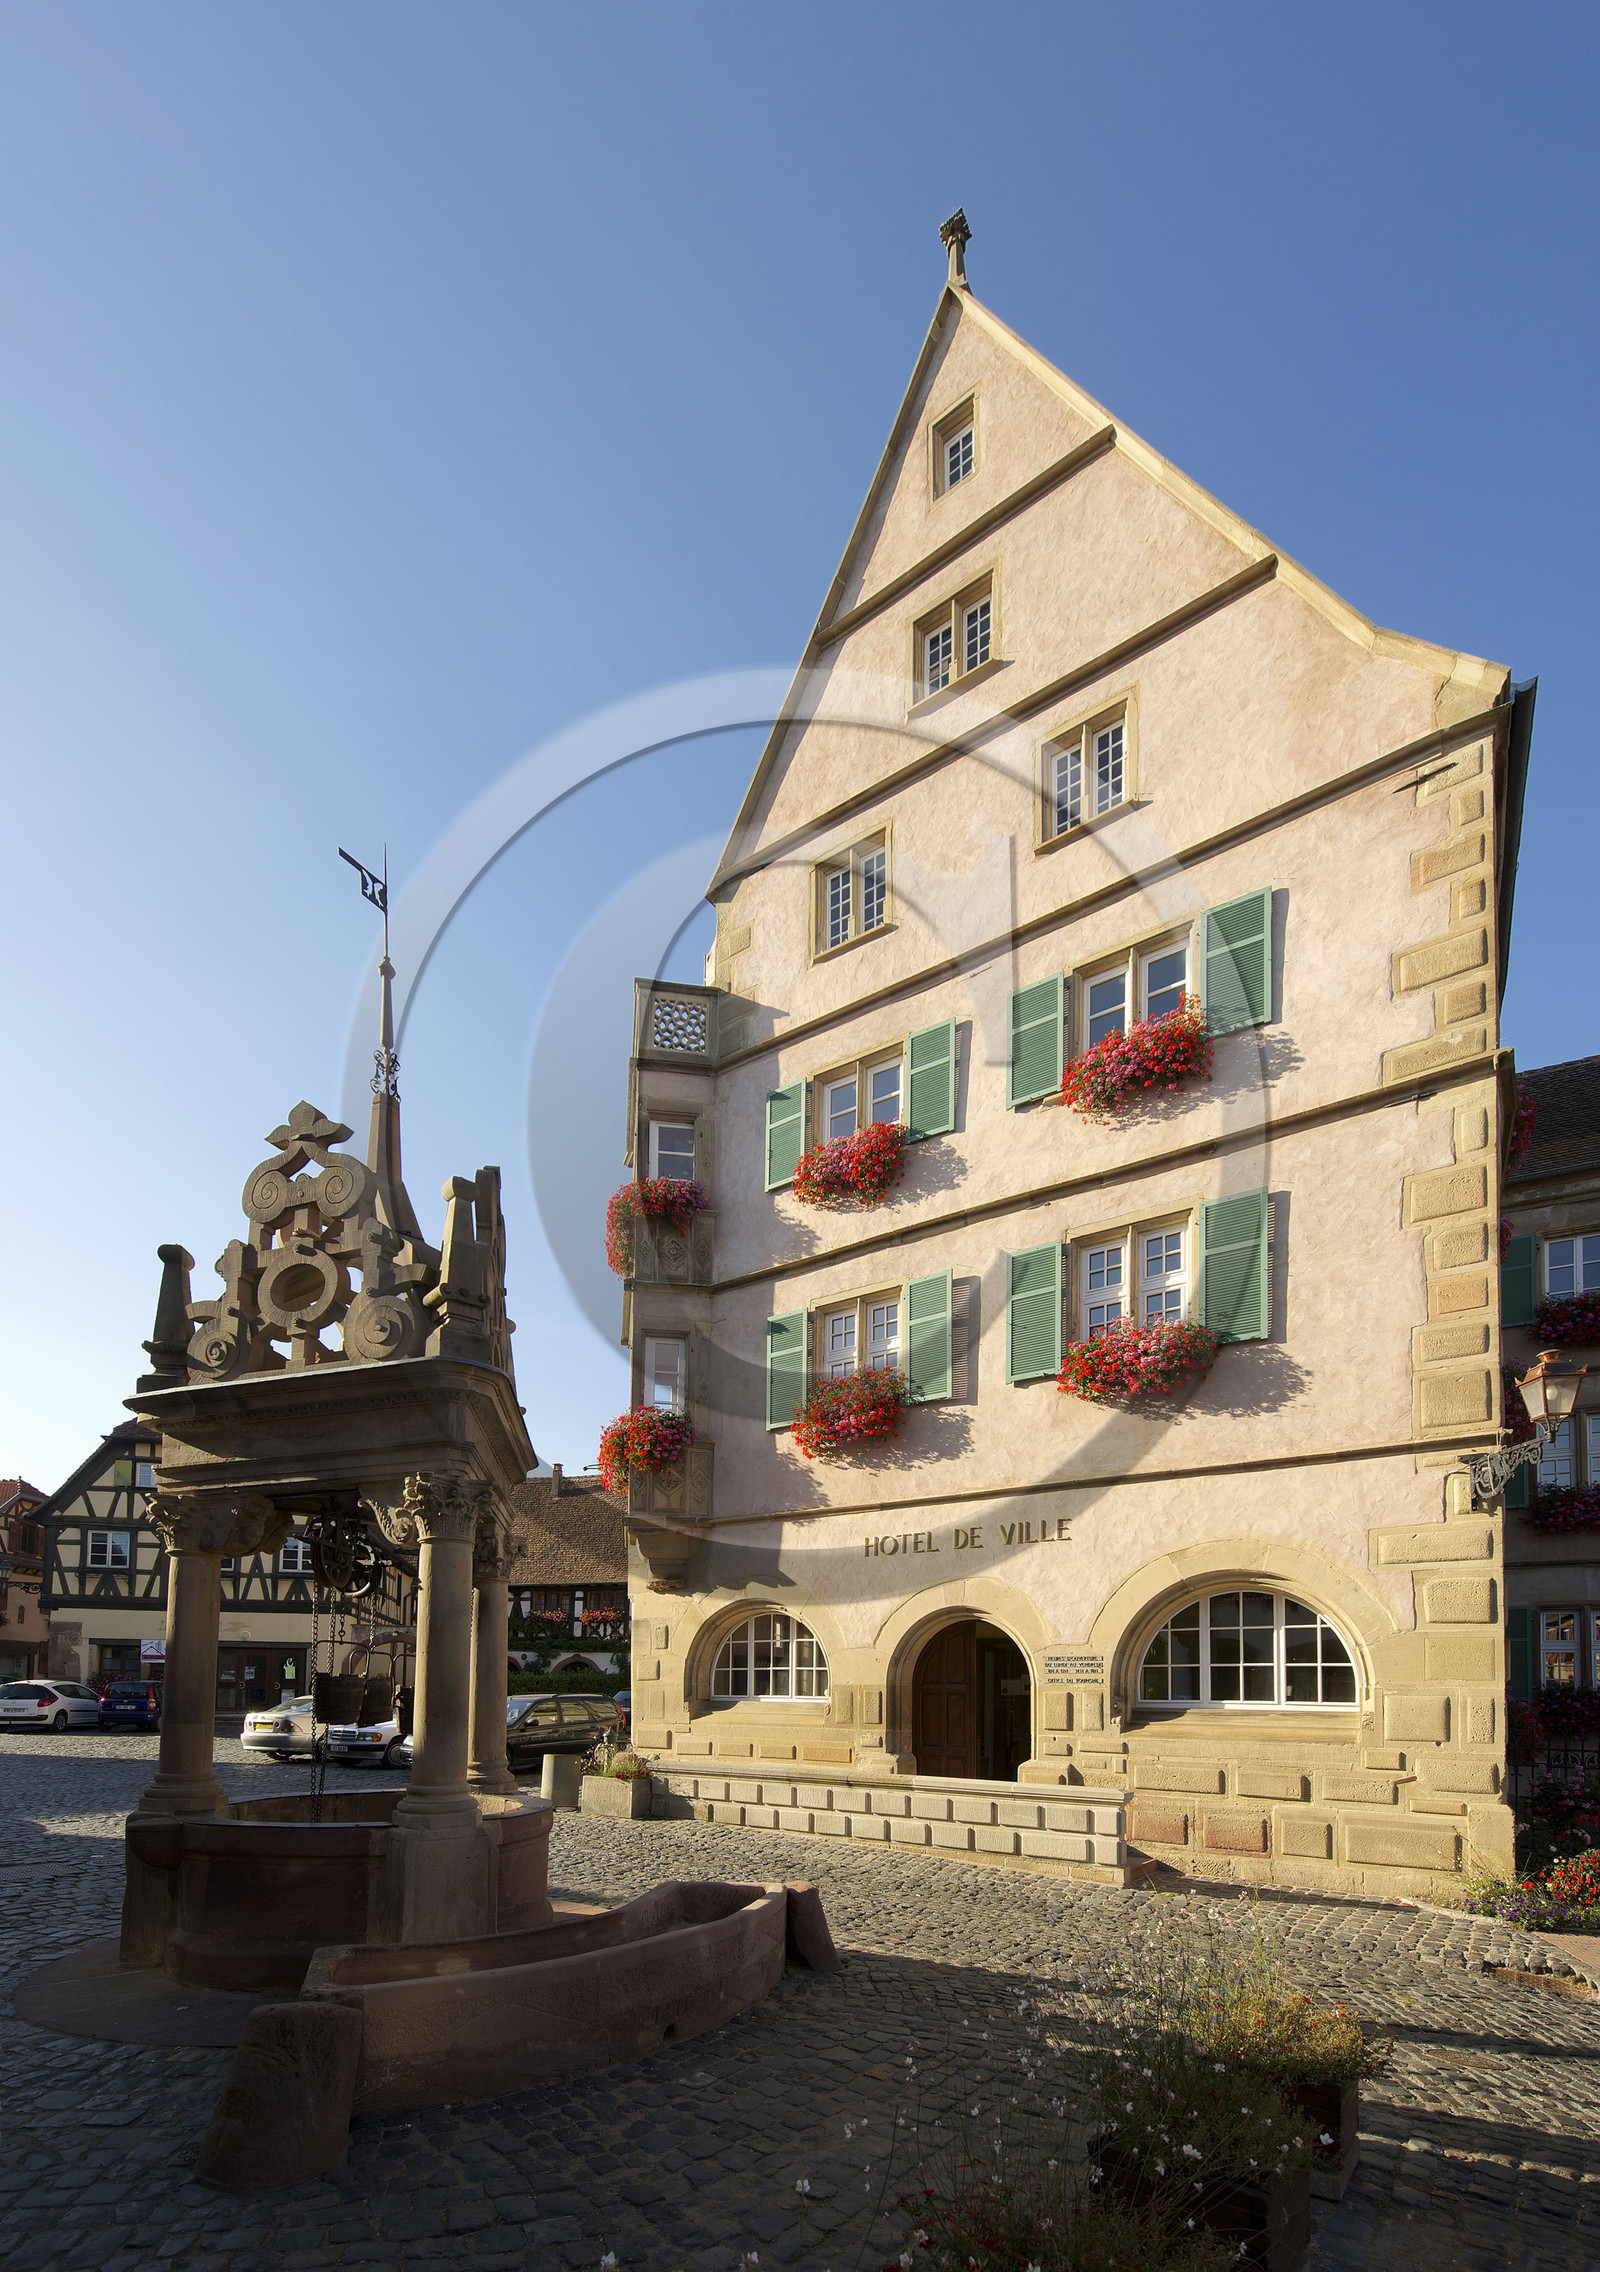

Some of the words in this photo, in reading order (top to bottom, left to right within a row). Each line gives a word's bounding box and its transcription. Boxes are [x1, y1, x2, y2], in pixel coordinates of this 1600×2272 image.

[864, 1531, 940, 1557] HOTEL
[952, 1526, 984, 1550] DE
[999, 1518, 1072, 1545] VILLE
